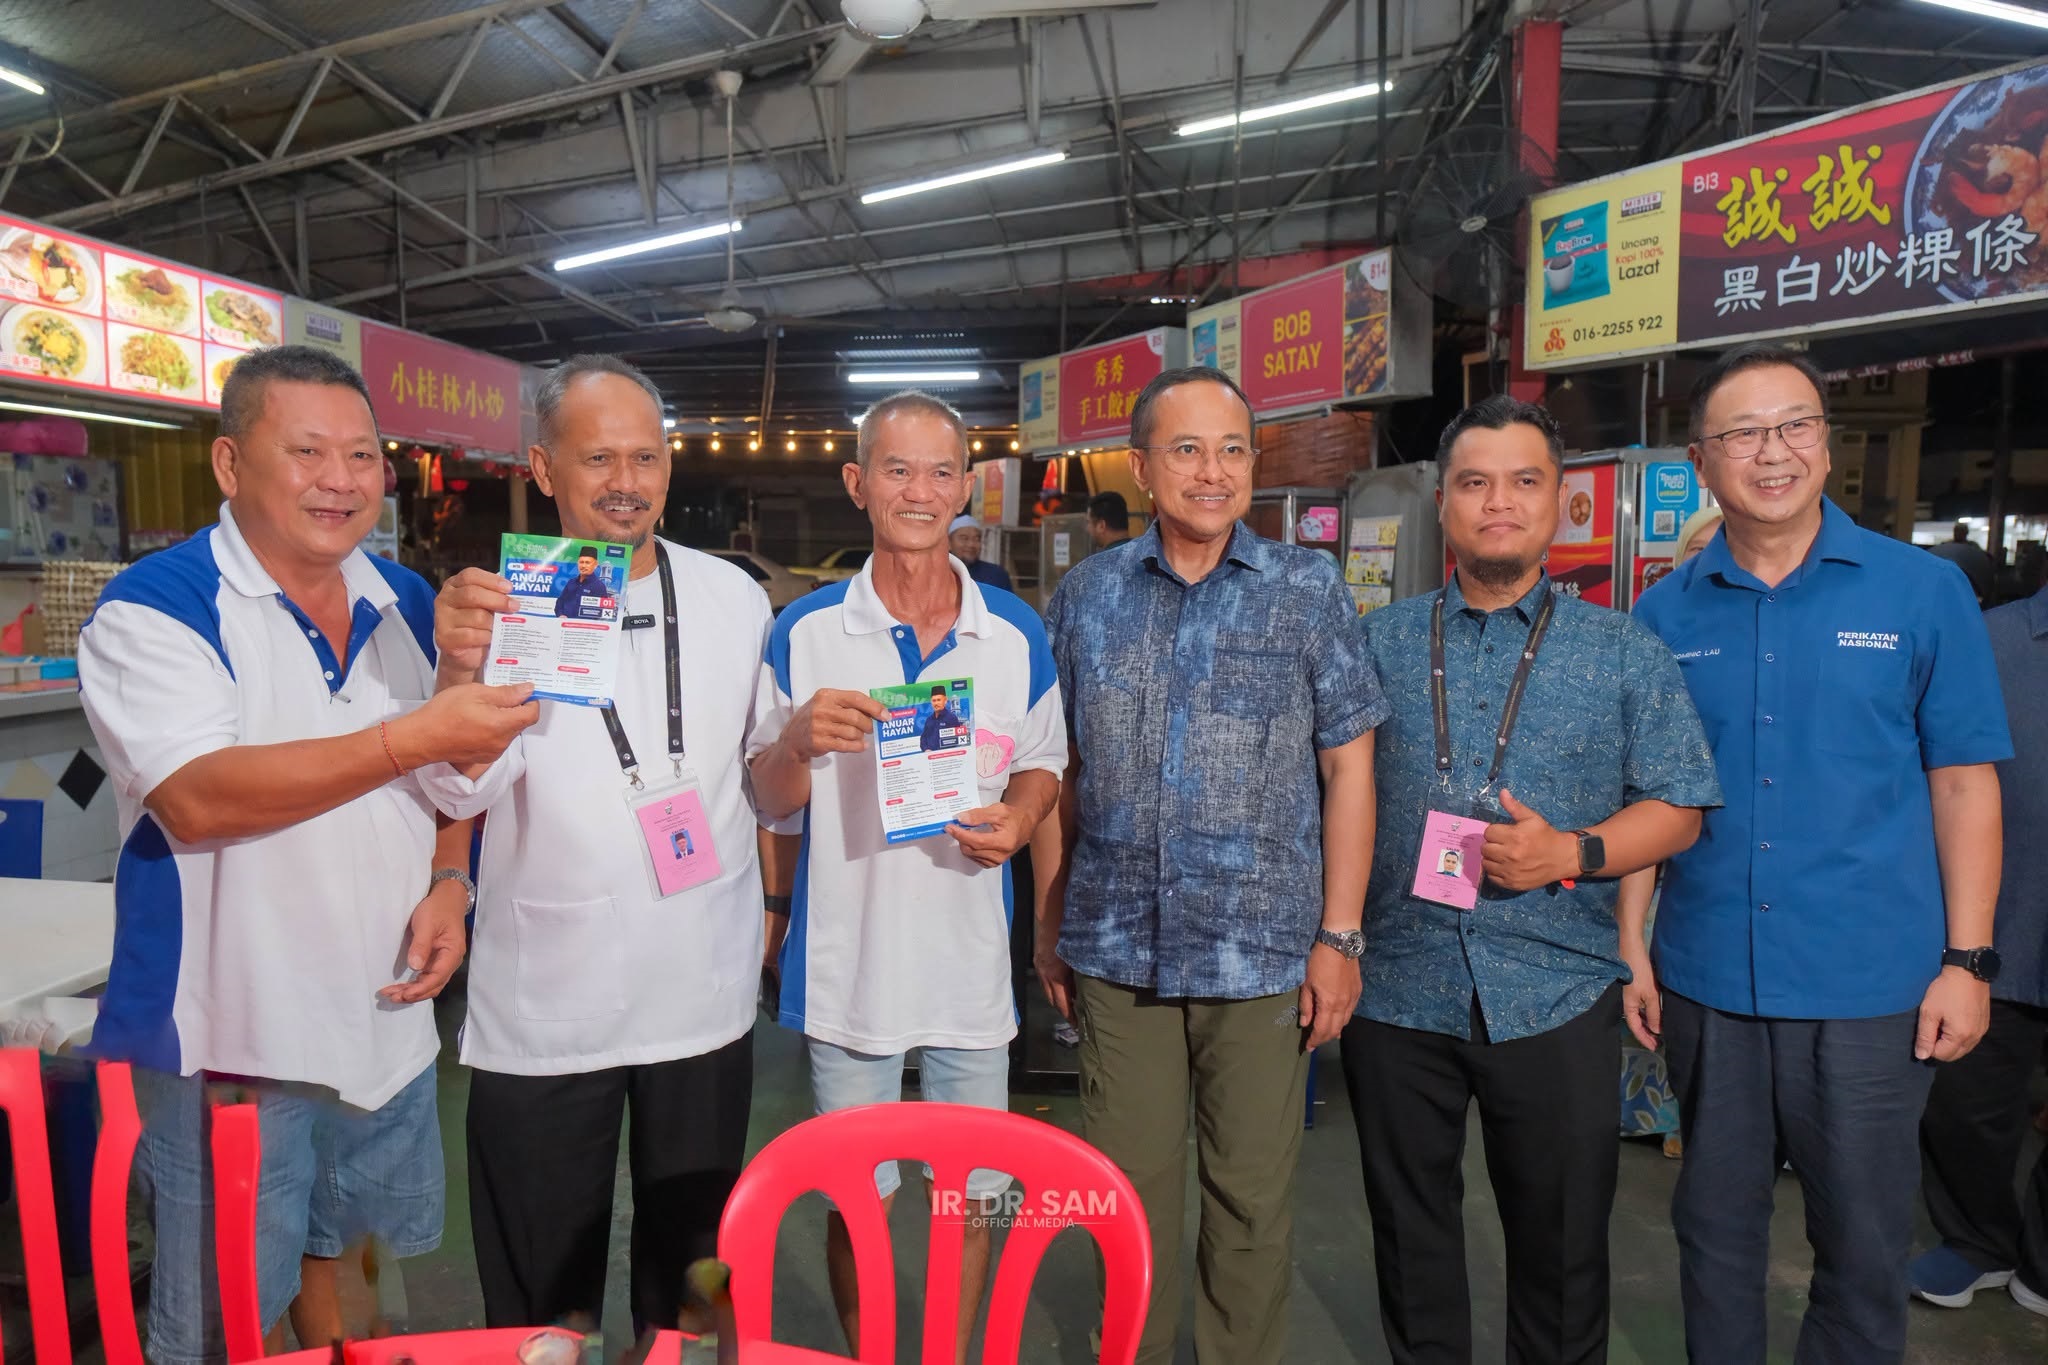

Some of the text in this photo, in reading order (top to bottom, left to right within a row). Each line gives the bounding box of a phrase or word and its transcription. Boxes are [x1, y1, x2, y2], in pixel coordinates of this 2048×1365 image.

[1716, 144, 1891, 248] 誠誠
[1621, 235, 1659, 250] Uncang
[1640, 247, 1664, 258] 100%
[1370, 261, 1386, 280] B14
[1619, 260, 1660, 280] Lazat
[1714, 213, 2039, 317] 黑白炒粿條
[1273, 310, 1311, 343] BOB
[1573, 320, 1633, 342] 016-2255
[1639, 315, 1663, 332] 922
[1263, 342, 1322, 379] SATAY
[390, 361, 504, 422] 小桂林小炒
[511, 573, 553, 584] ANUAR
[511, 582, 550, 593] HAYAN
[602, 599, 612, 607] 01
[1837, 631, 1898, 642] PERIKATAN
[1838, 639, 1897, 650] NASIONAL
[1704, 648, 1720, 656] LAU
[882, 718, 915, 730] ANUAR
[882, 726, 914, 738] HAYAN
